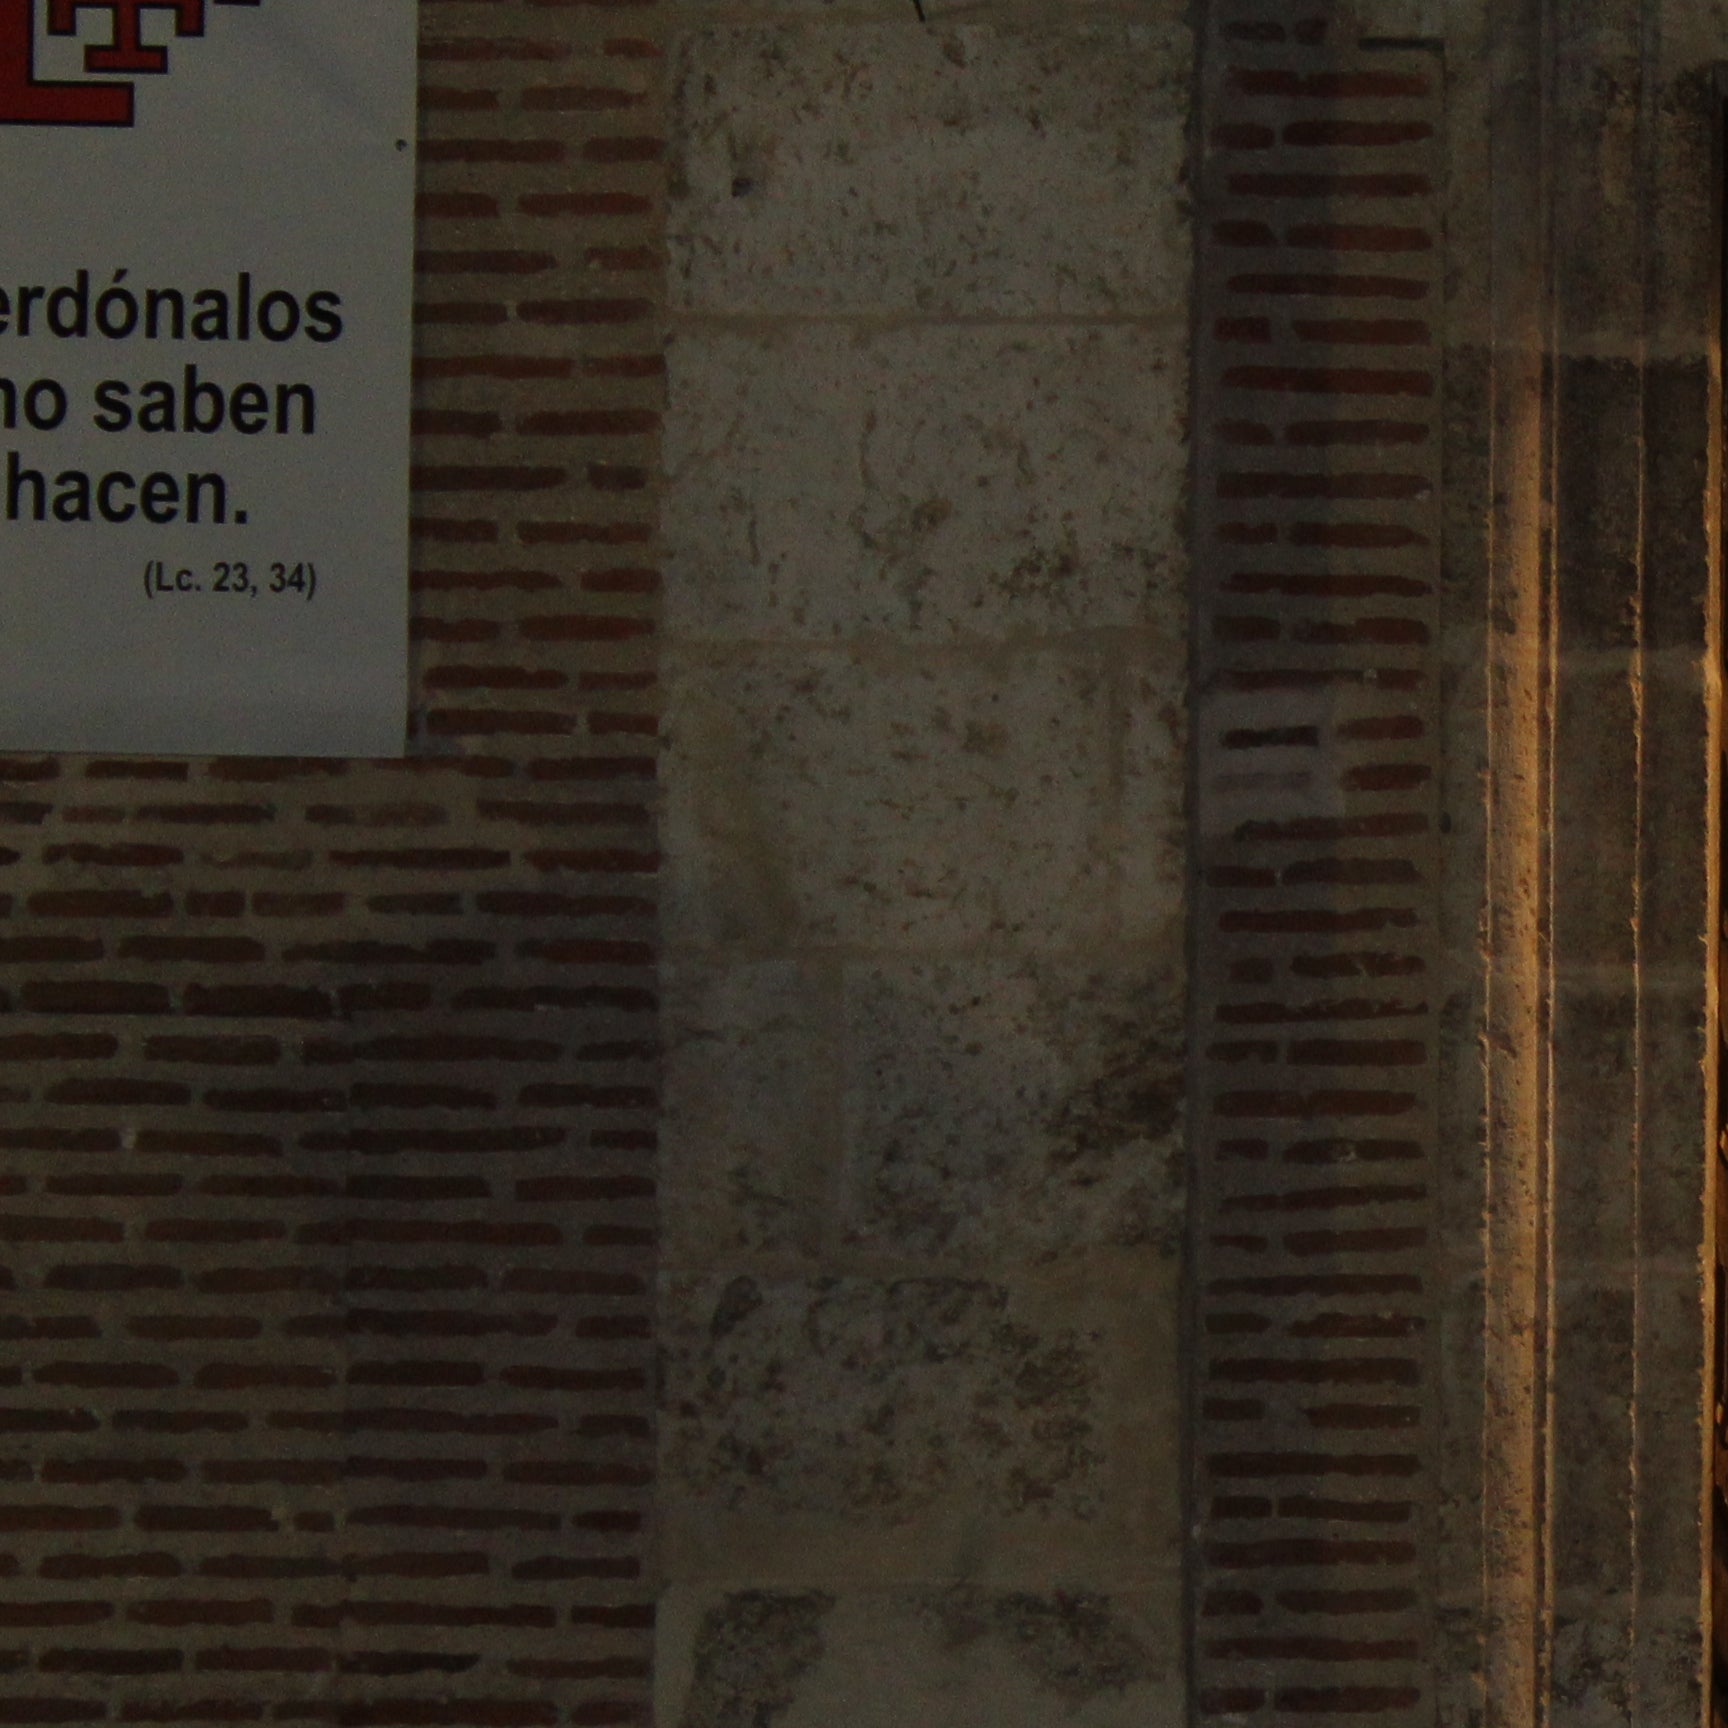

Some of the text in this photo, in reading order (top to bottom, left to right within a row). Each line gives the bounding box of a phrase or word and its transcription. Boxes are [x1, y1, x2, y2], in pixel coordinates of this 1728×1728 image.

[0, 268, 343, 343] rdónalos
[93, 363, 315, 435] saben
[6, 451, 247, 525] hacen.
[144, 561, 317, 600] (Lc. 23, 34)
